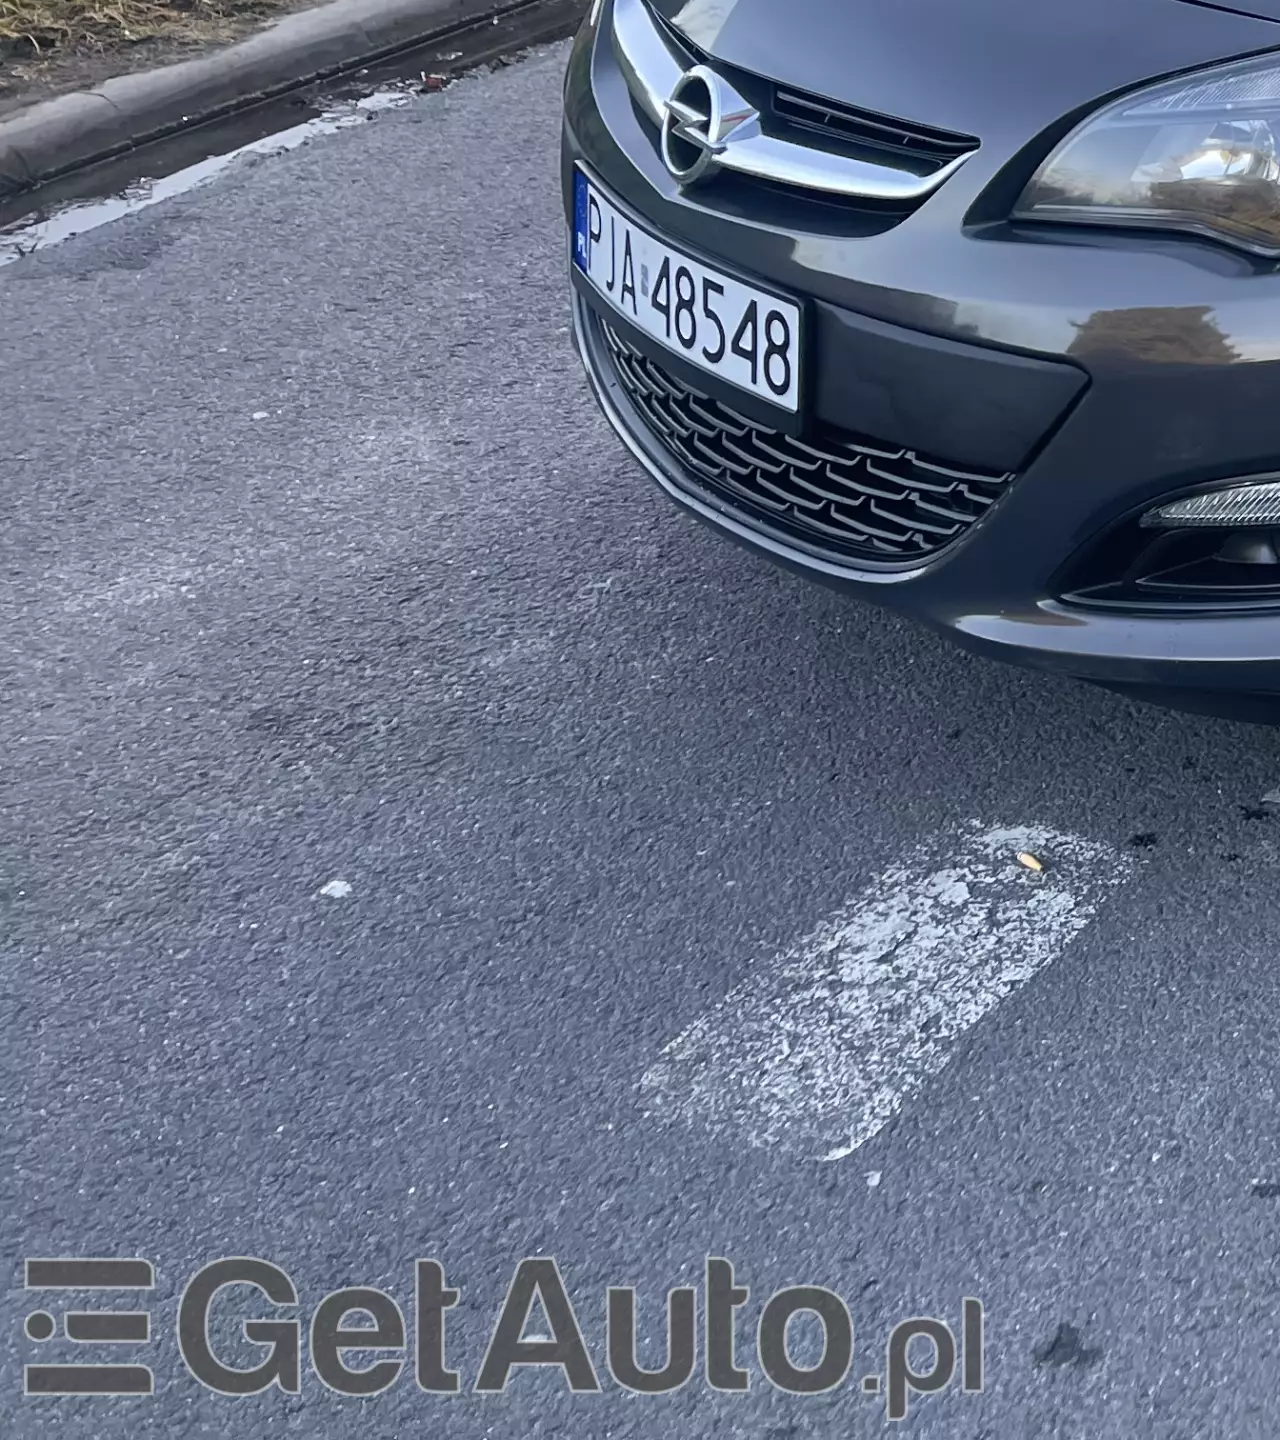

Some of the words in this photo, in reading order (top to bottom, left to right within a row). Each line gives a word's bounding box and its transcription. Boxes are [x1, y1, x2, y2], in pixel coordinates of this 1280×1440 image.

[577, 231, 587, 258] PL
[588, 193, 638, 316] PJA
[651, 255, 792, 396] 48548
